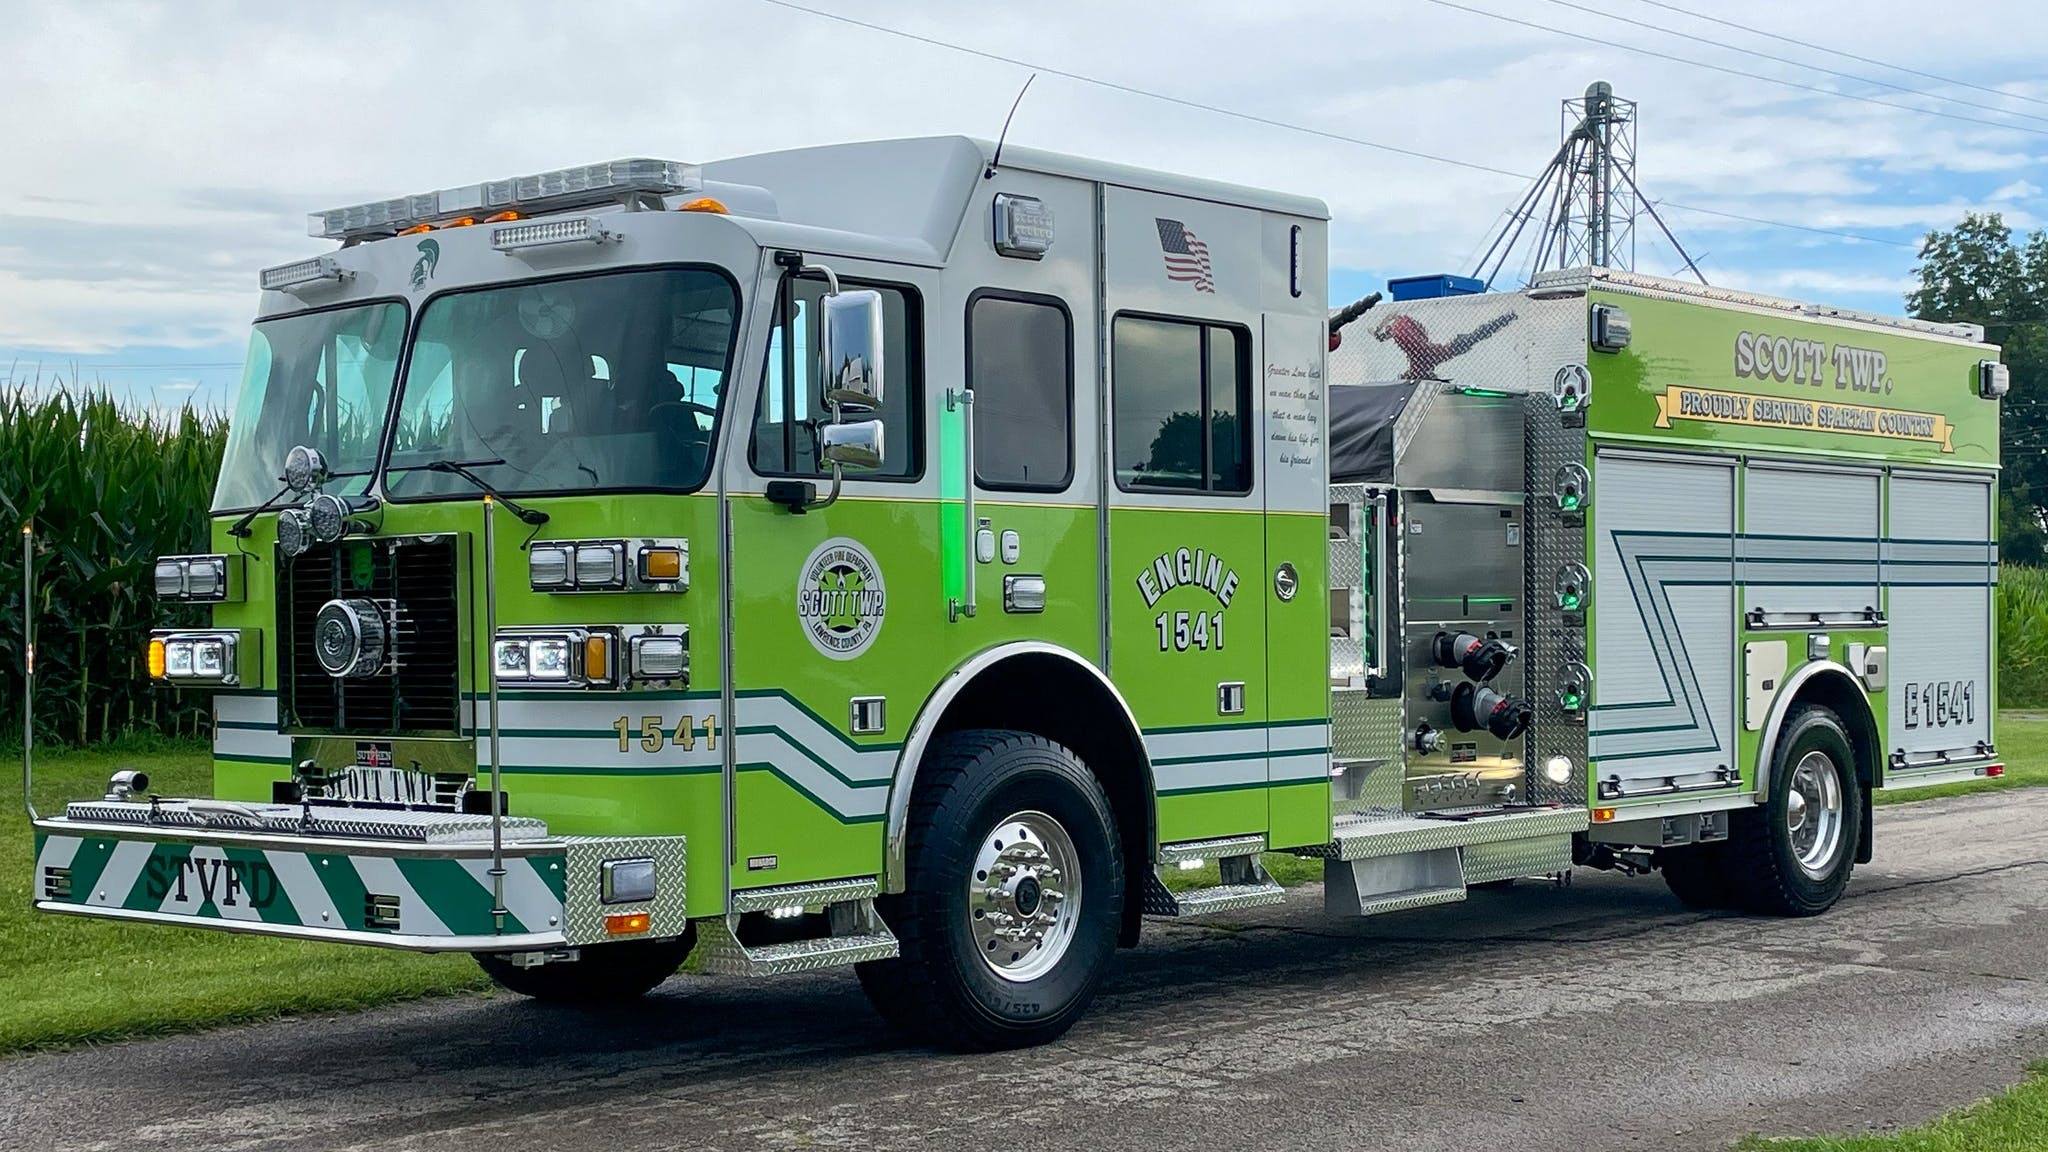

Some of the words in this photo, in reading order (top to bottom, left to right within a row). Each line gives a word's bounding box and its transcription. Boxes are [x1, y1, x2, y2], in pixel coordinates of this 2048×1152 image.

[1735, 331, 1827, 386] SCOTT
[1831, 344, 1894, 395] TWP.
[1680, 392, 1751, 420] PROUDLY
[1752, 399, 1814, 427] SERVING
[1818, 406, 1876, 432] SPARTAN
[1878, 413, 1935, 438] COUNTRY
[1136, 547, 1240, 609] ENGINE
[799, 590, 849, 617] SCOTT
[851, 590, 884, 617] TWP.
[1155, 611, 1224, 651] 1541
[1905, 682, 1918, 730] E
[1923, 680, 1975, 728] 1541
[613, 715, 716, 752] 1541
[325, 766, 383, 802] SCOTT
[391, 769, 433, 805] TWP
[147, 854, 278, 909] STVFD
